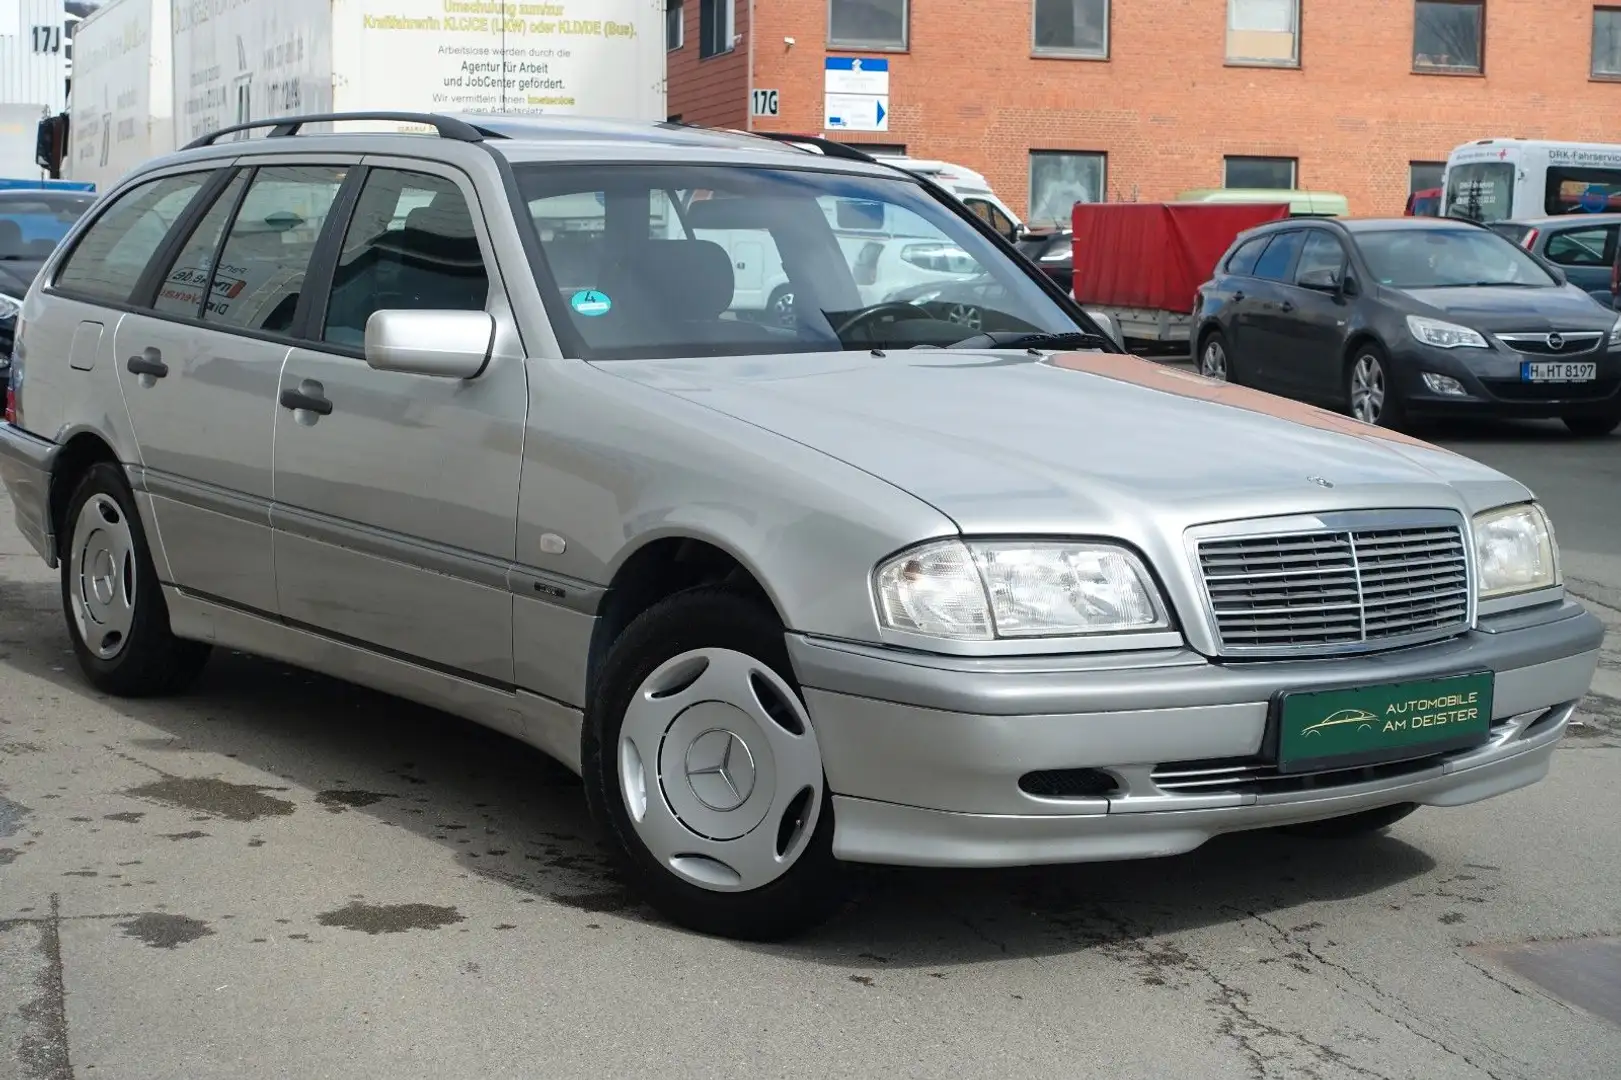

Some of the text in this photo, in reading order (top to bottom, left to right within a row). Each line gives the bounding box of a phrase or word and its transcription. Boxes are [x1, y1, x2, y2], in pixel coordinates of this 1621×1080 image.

[32, 26, 60, 53] 17J
[438, 45, 571, 58] Arbeitslose werden durch die
[461, 60, 548, 75] Agentur für Arbeit
[444, 76, 565, 91] und JobCenter gefördert.
[432, 93, 449, 102] Wir
[753, 90, 778, 115] 17G
[584, 290, 597, 303] 4
[1530, 364, 1594, 378] H HT 8197
[1385, 691, 1478, 715] AUTOMOBILE
[1382, 708, 1478, 734] AM DEISTER
